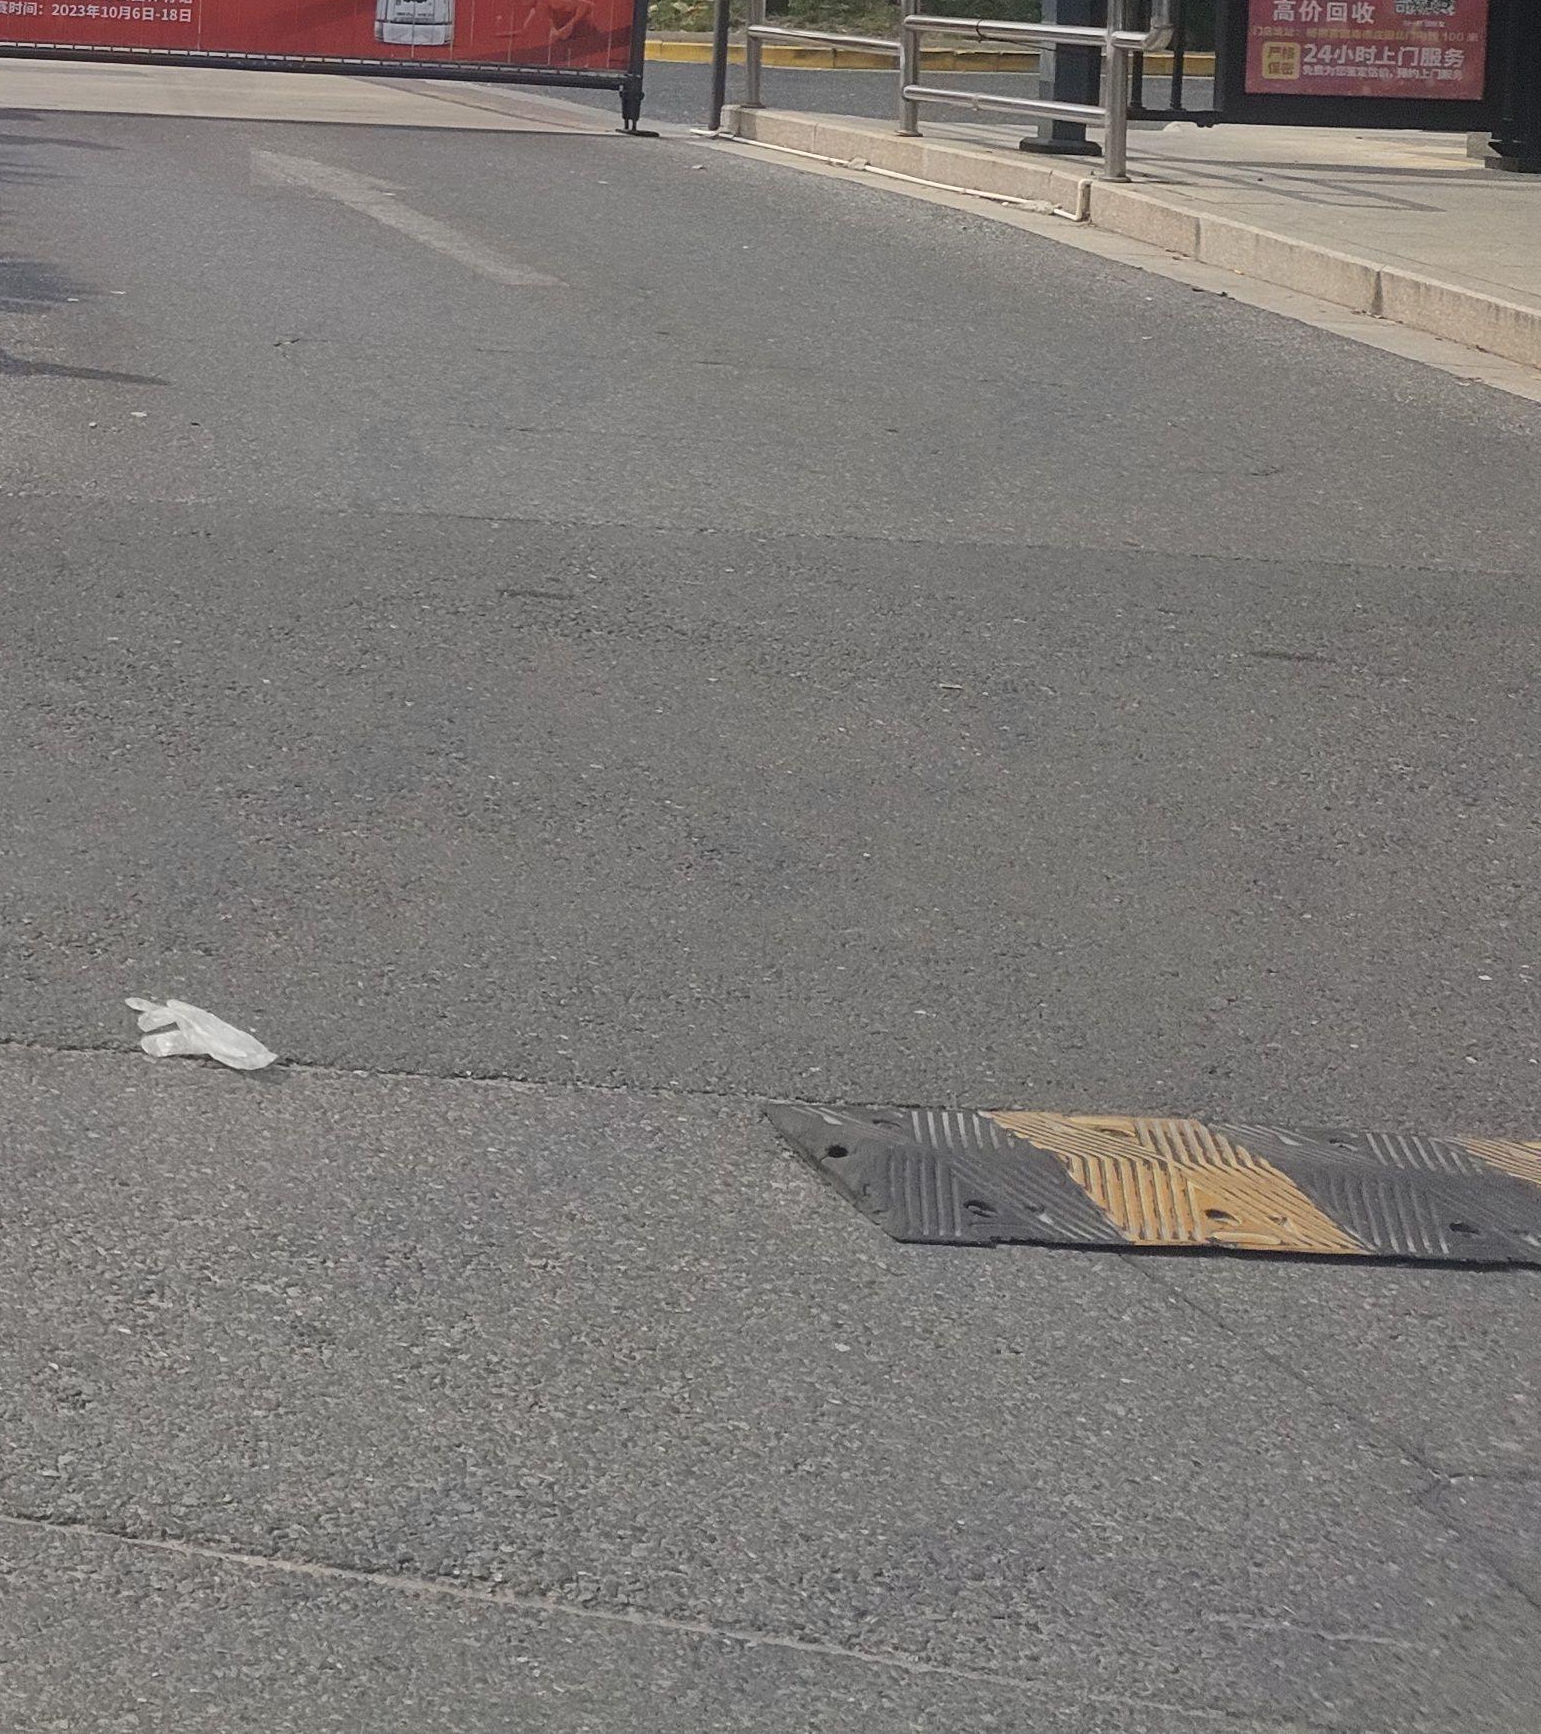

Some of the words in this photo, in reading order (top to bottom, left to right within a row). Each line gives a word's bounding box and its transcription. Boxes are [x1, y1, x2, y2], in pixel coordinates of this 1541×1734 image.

[1273, 0, 1376, 25] 高价回收
[1303, 44, 1465, 68] 24小时上门服务
